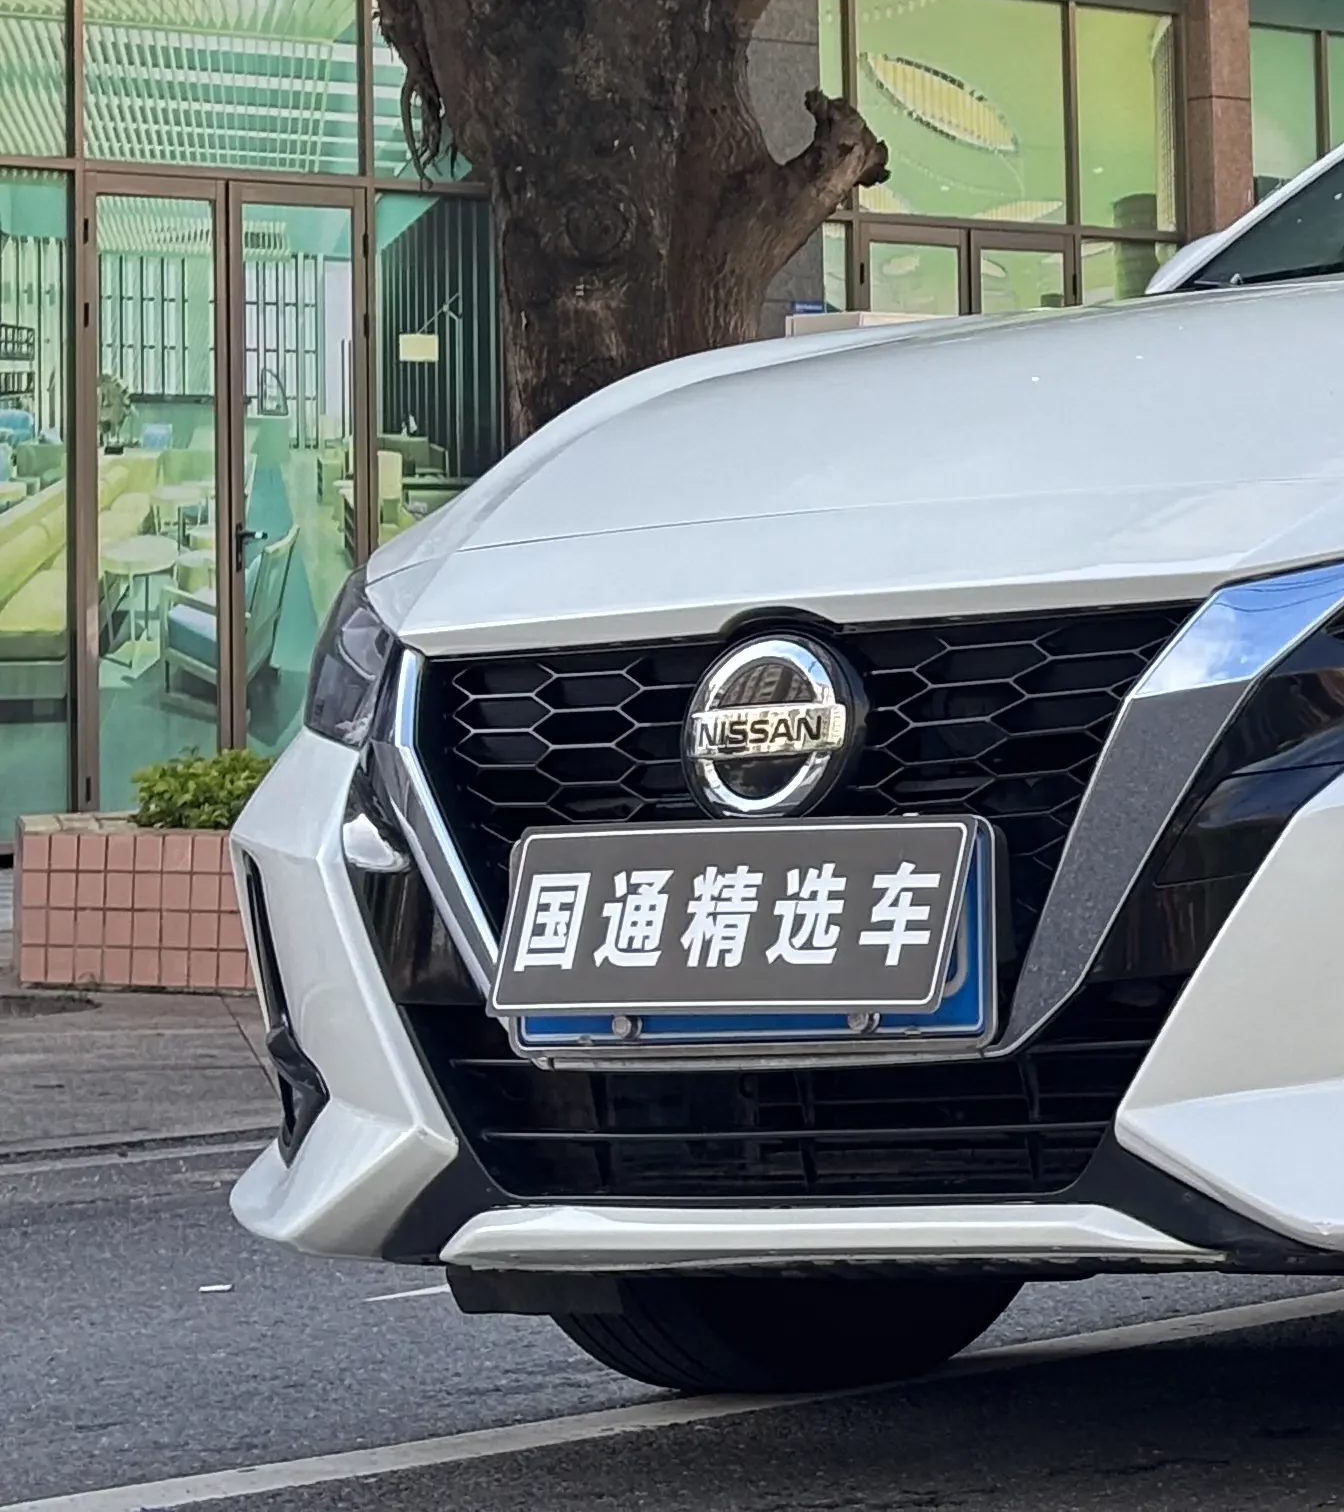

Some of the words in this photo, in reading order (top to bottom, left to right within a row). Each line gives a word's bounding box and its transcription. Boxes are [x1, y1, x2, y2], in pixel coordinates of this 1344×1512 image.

[698, 714, 823, 748] NISSAN
[513, 862, 942, 972] 国通精选车
